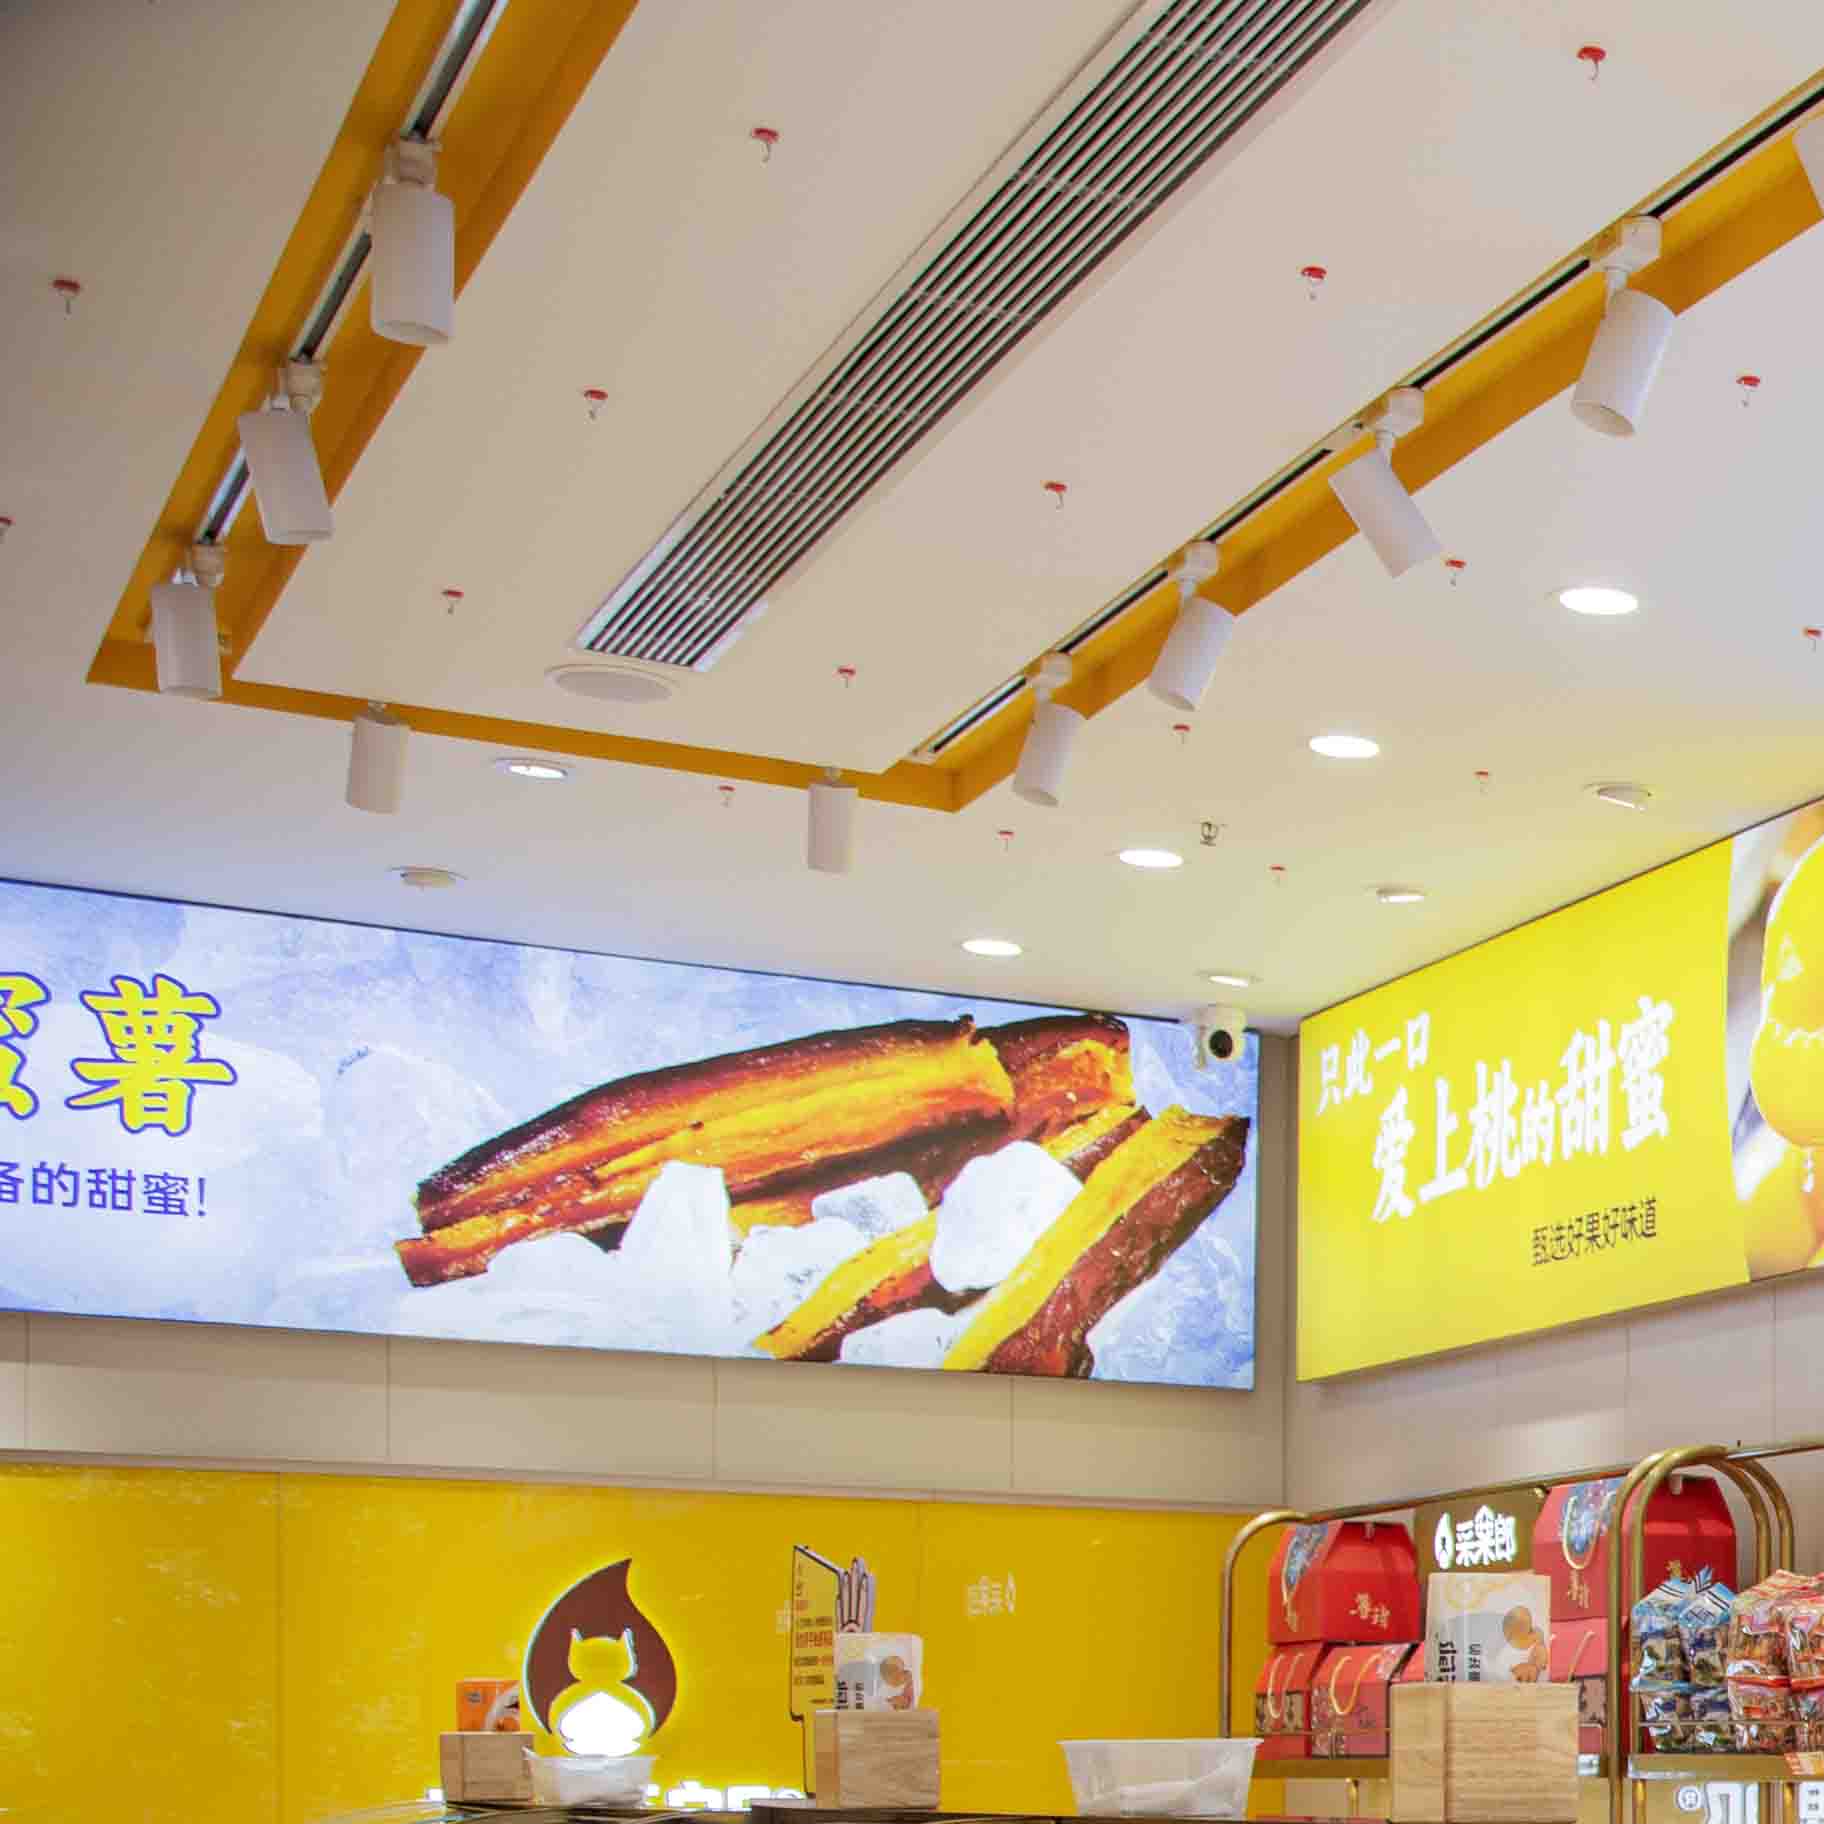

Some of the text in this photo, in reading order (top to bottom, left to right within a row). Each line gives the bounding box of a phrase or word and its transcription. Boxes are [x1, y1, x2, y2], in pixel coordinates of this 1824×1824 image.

[1316, 1010, 1432, 1116] 只此一口
[1371, 994, 1675, 1224] 爱上桃的甜蜜
[1532, 1196, 1658, 1267] 甄选好果好味道
[1455, 1504, 1518, 1568] 采果郎
